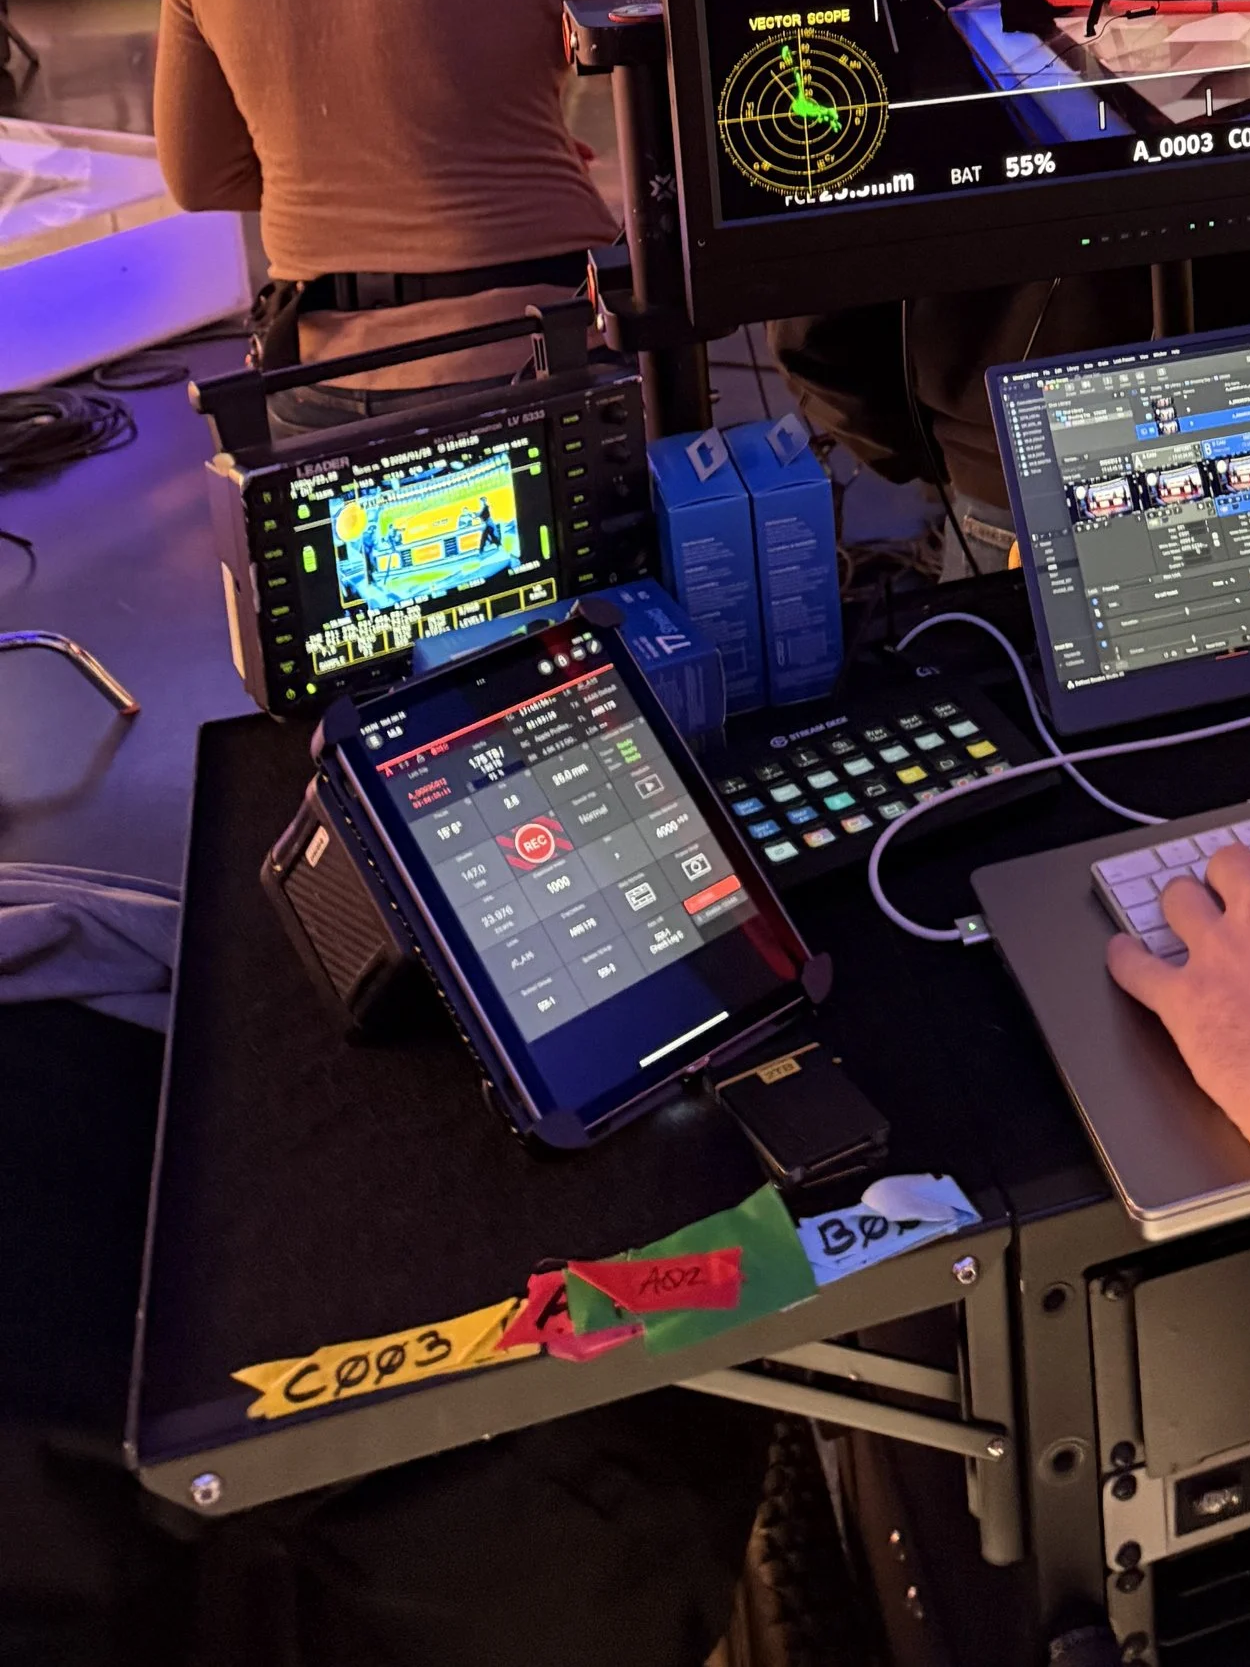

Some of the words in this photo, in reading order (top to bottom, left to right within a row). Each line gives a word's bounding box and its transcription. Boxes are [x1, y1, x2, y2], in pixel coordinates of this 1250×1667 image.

[749, 13, 801, 31] VECTOR
[806, 9, 851, 26] SCOPE
[1133, 133, 1214, 162] A_0003
[951, 165, 982, 185] BAT
[1005, 152, 1056, 178] 55%
[1203, 442, 1212, 456] B
[296, 455, 350, 478] LEADER
[1134, 455, 1143, 470] A
[789, 723, 825, 741] STREAM
[523, 834, 548, 854] REC
